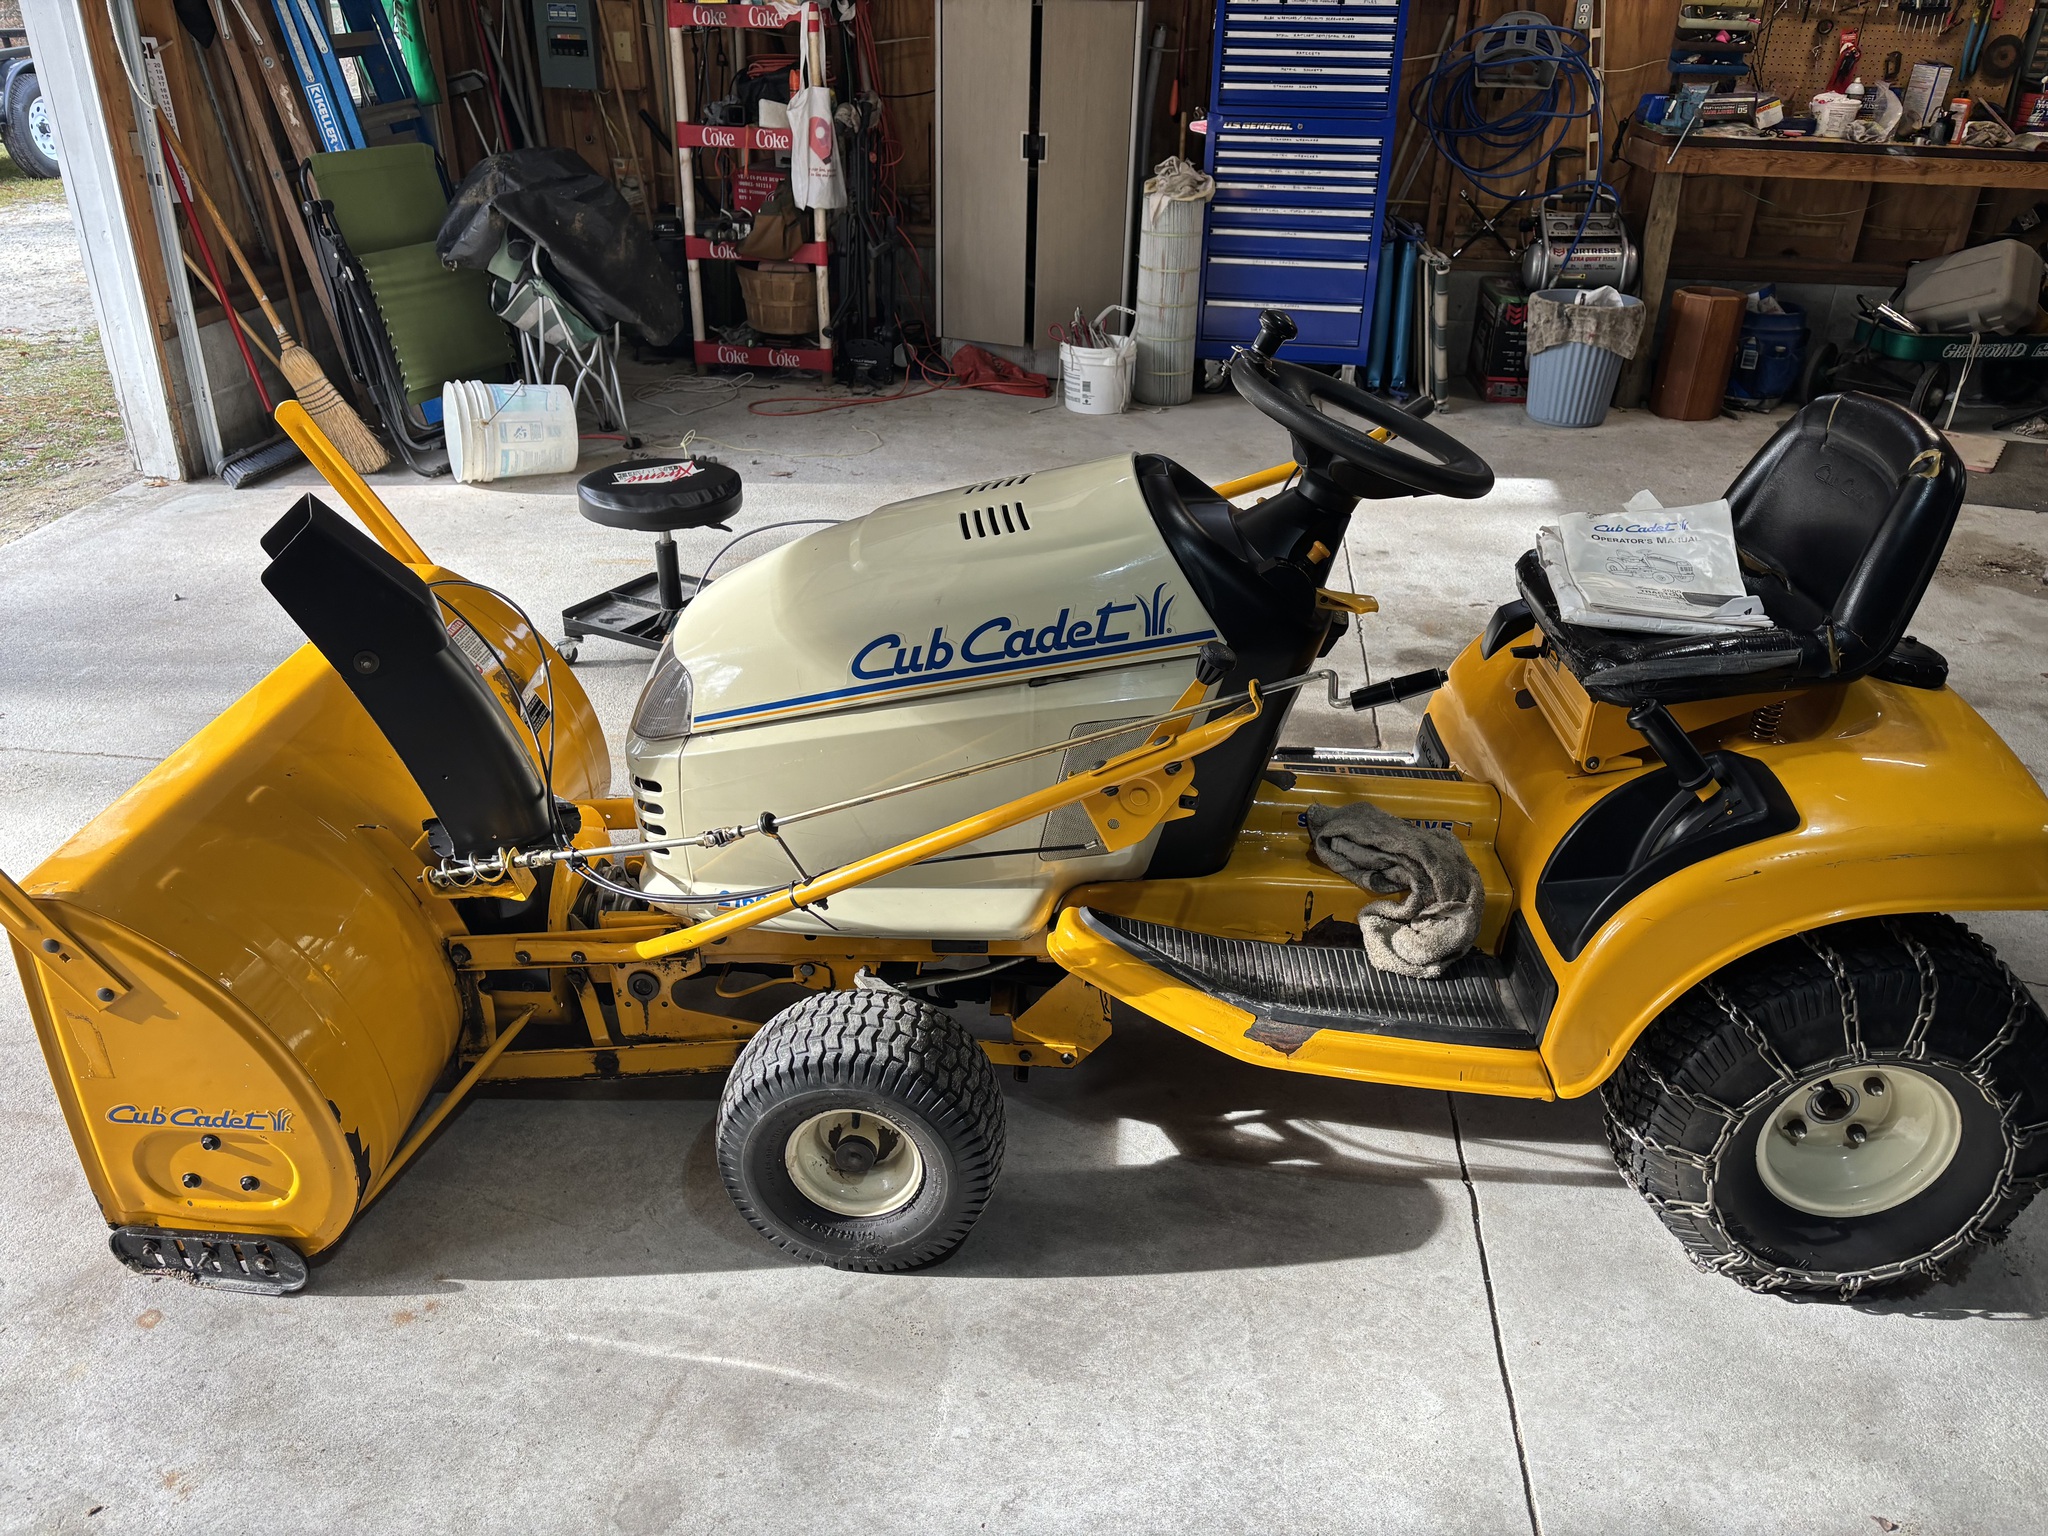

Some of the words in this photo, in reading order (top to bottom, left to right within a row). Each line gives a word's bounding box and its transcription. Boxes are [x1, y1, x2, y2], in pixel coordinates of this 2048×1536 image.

[692, 5, 727, 26] Coke
[748, 6, 783, 27] Coke
[314, 98, 338, 144] KELLER
[1242, 122, 1293, 131] GENERAL
[702, 127, 735, 147] Coke
[756, 129, 789, 149] Coke
[717, 346, 749, 365] Coke
[768, 348, 800, 367] Coke
[1593, 523, 1624, 533] Cub
[1625, 521, 1677, 533] Cadet
[1591, 534, 1654, 545] OPERATOR'S
[1657, 536, 1702, 545] MANUAL
[851, 626, 954, 680] Cub
[961, 602, 1137, 664] Cadet
[108, 1105, 167, 1125] Cub
[170, 1108, 269, 1131] Cadet
